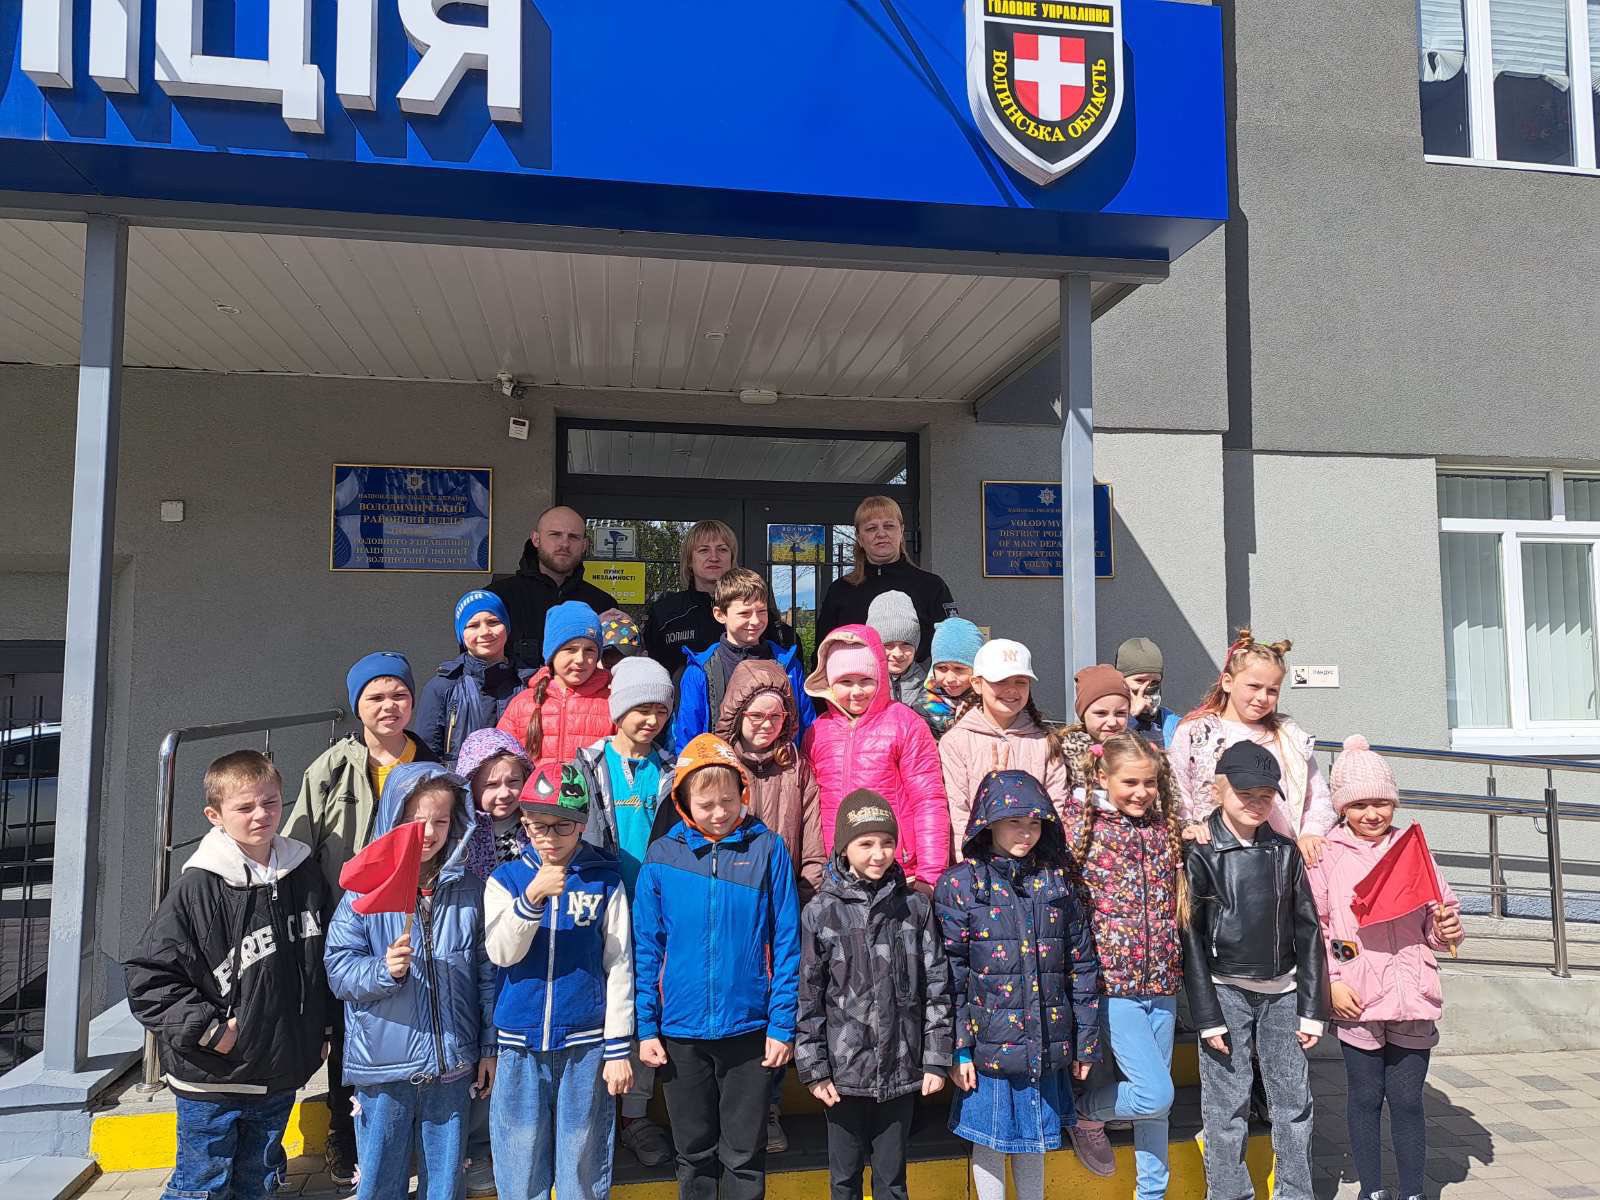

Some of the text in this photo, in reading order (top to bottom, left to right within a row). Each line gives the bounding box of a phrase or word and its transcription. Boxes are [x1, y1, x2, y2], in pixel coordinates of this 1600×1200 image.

[988, 0, 1110, 23] ГОЛОВНЕ УПРАВЛІННЯ
[993, 49, 1107, 142] ВОЛИНСЬКА ОБЛАСТЬ
